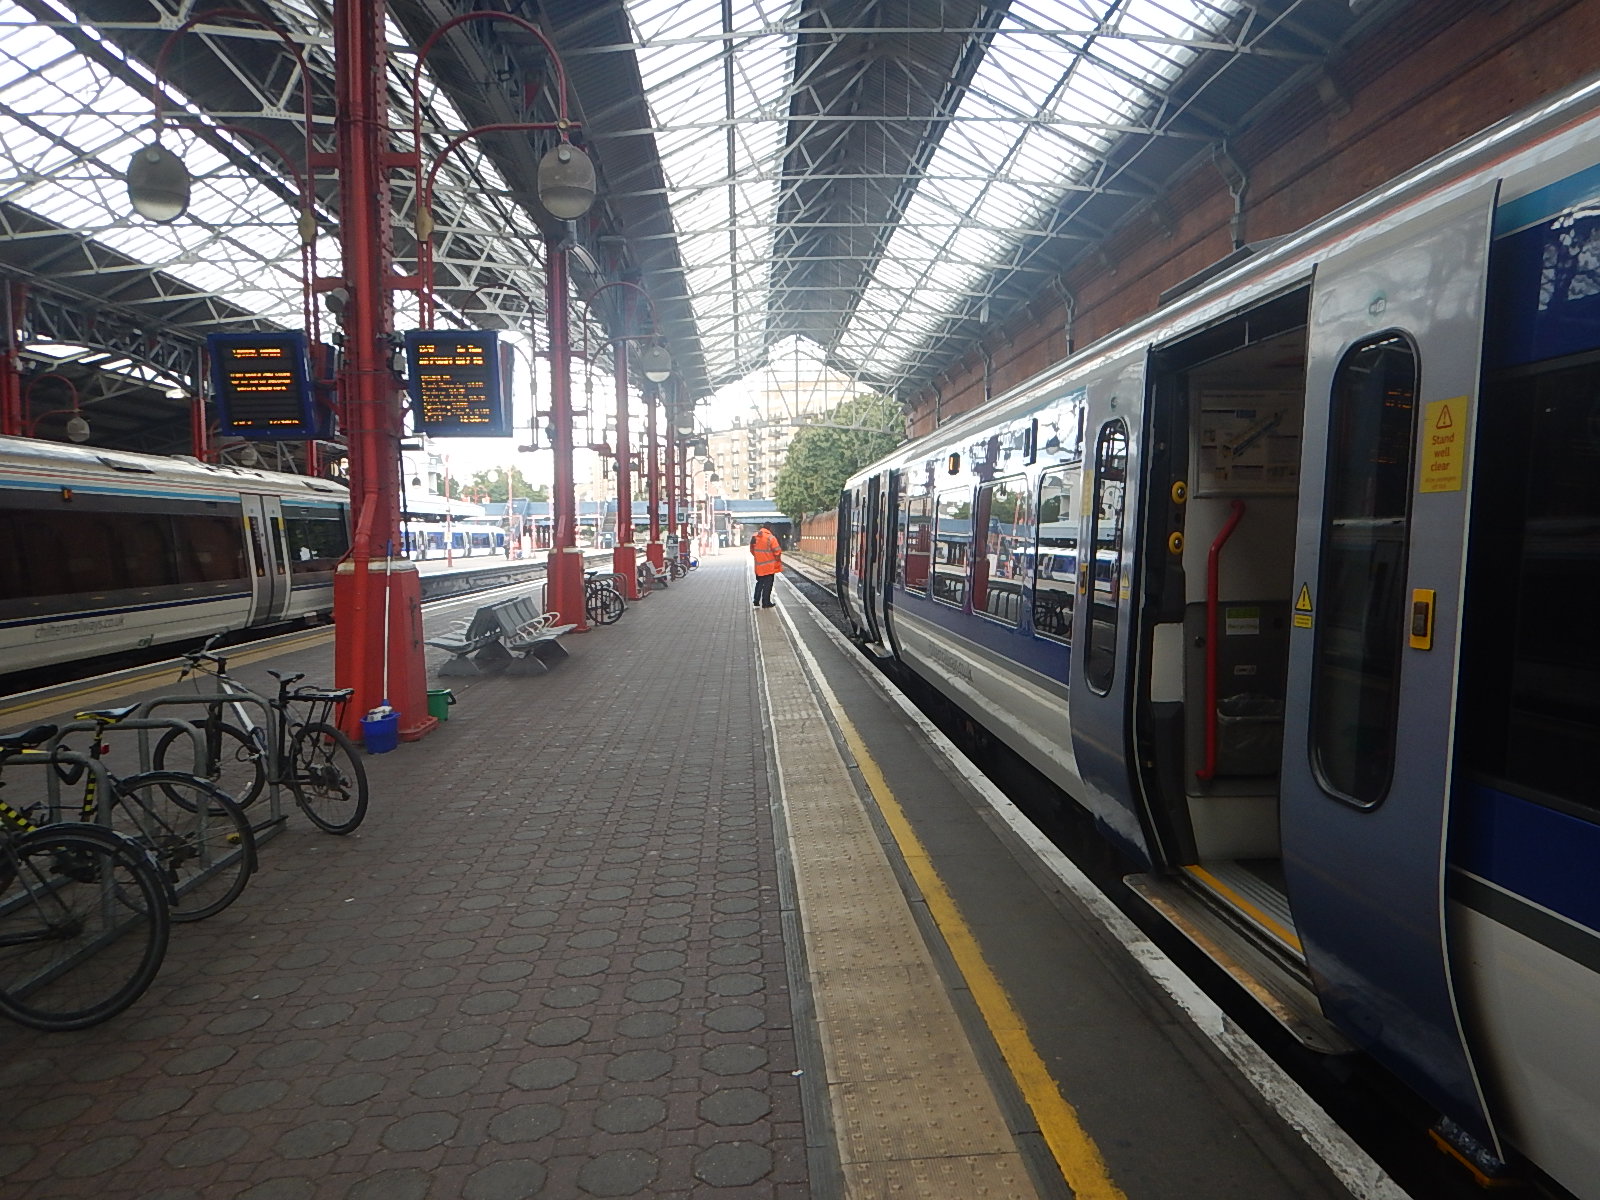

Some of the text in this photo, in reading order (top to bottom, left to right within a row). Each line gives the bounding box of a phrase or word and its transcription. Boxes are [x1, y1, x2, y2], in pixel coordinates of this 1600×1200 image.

[1432, 432, 1455, 446] Stand
[1434, 446, 1450, 458] well
[1430, 461, 1451, 472] clear
